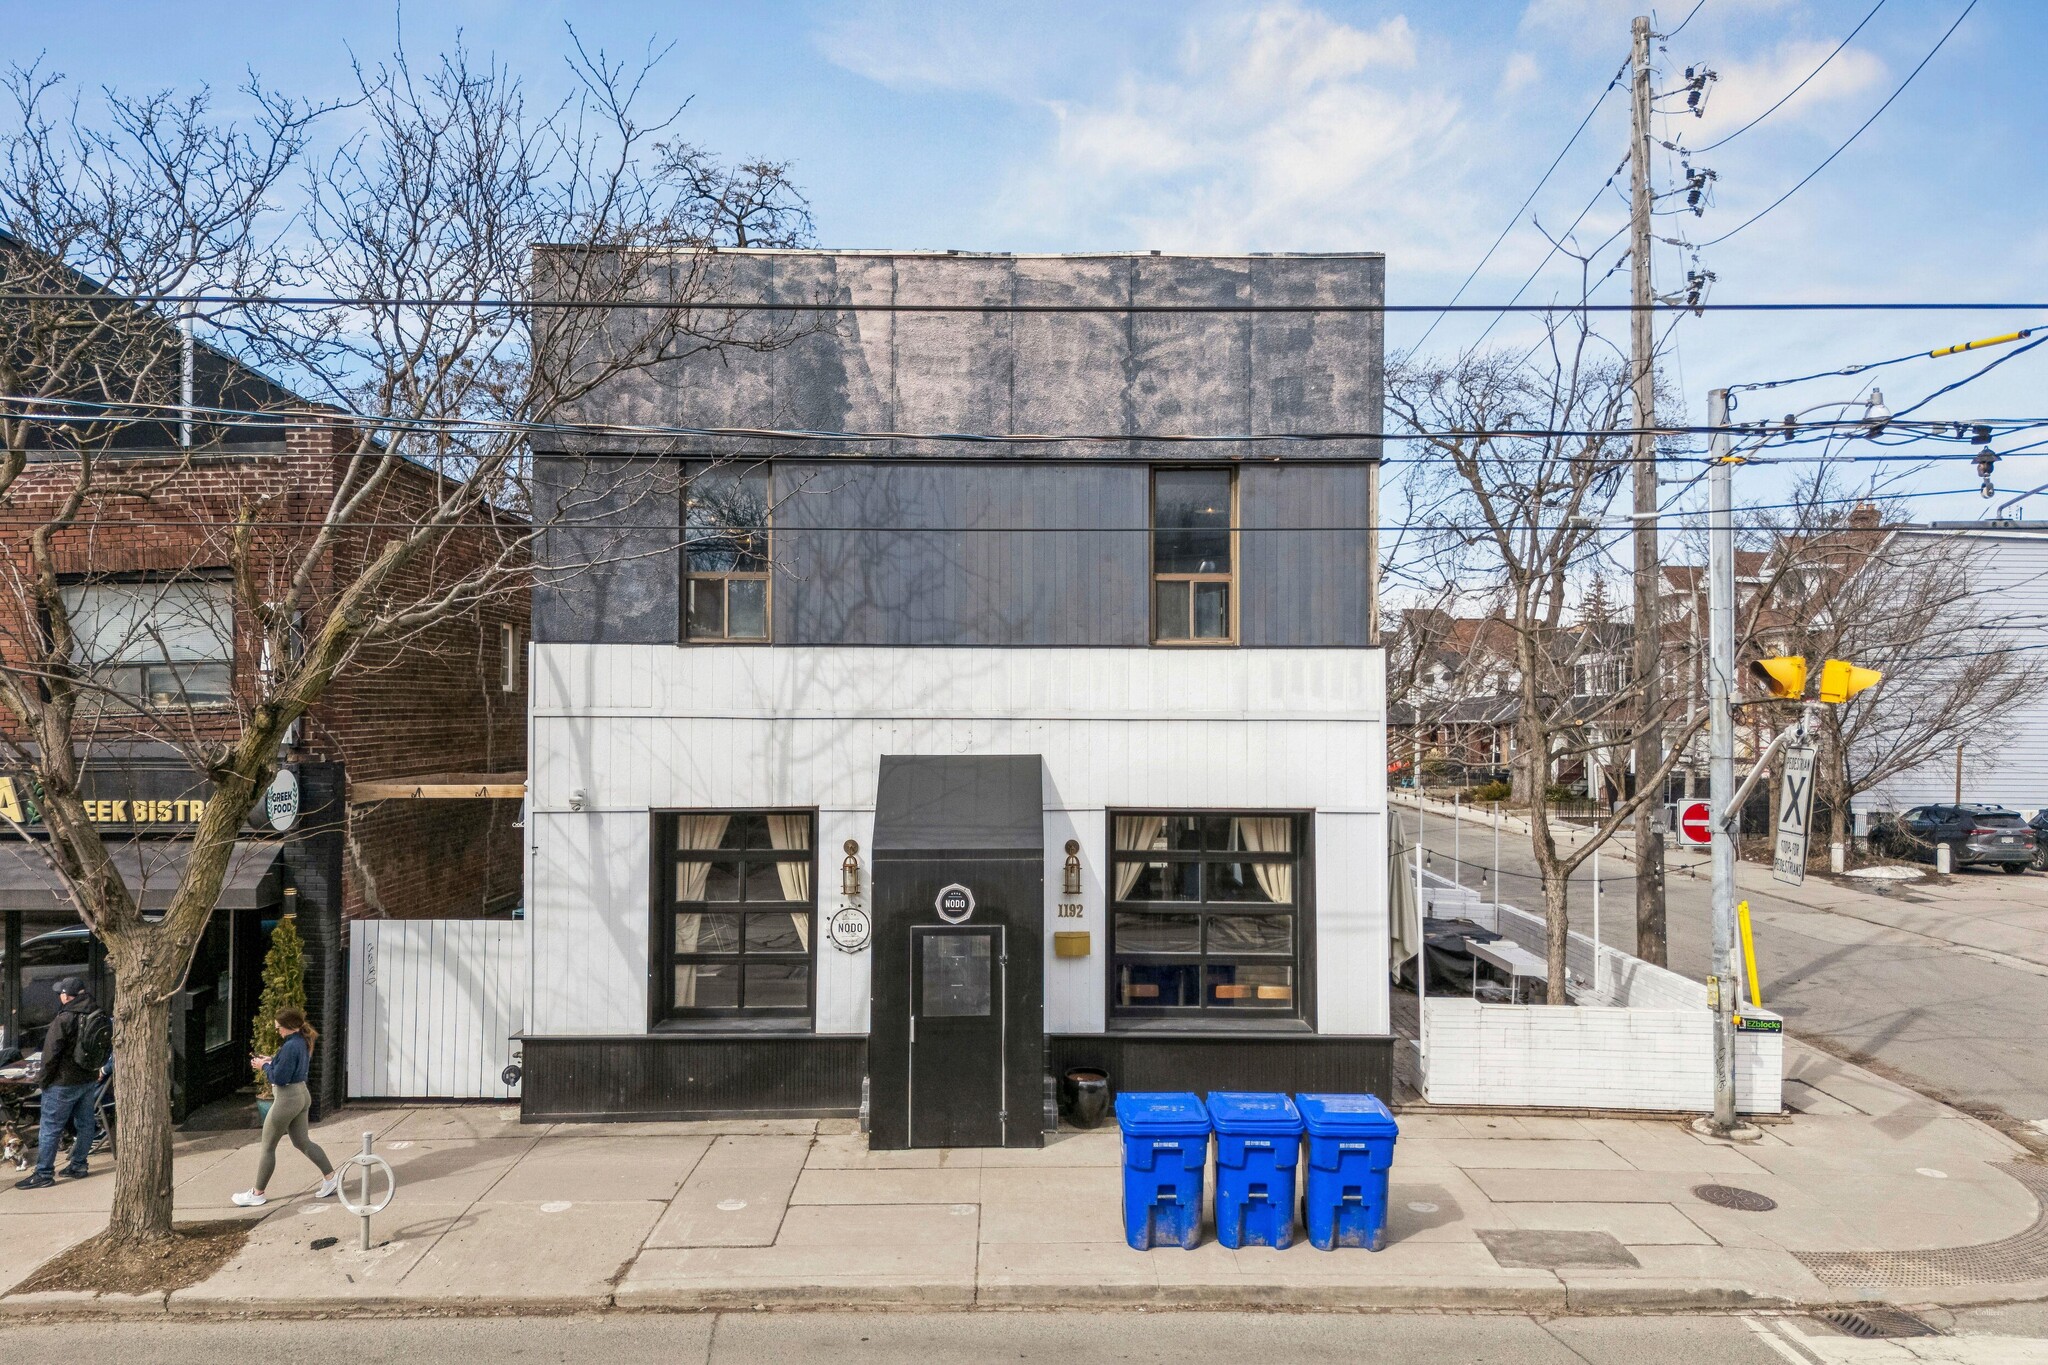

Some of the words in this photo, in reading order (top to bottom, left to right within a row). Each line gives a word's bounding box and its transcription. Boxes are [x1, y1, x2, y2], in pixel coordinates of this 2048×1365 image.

[272, 791, 293, 802] GREEK
[1782, 775, 1806, 826] X
[83, 800, 128, 822] EEK
[133, 800, 210, 822] BISTR
[273, 803, 292, 814] FOOD
[945, 899, 966, 908] NODO
[1057, 903, 1084, 918] 1192
[838, 923, 863, 933] NODO
[1746, 1020, 1780, 1028] EZblocks
